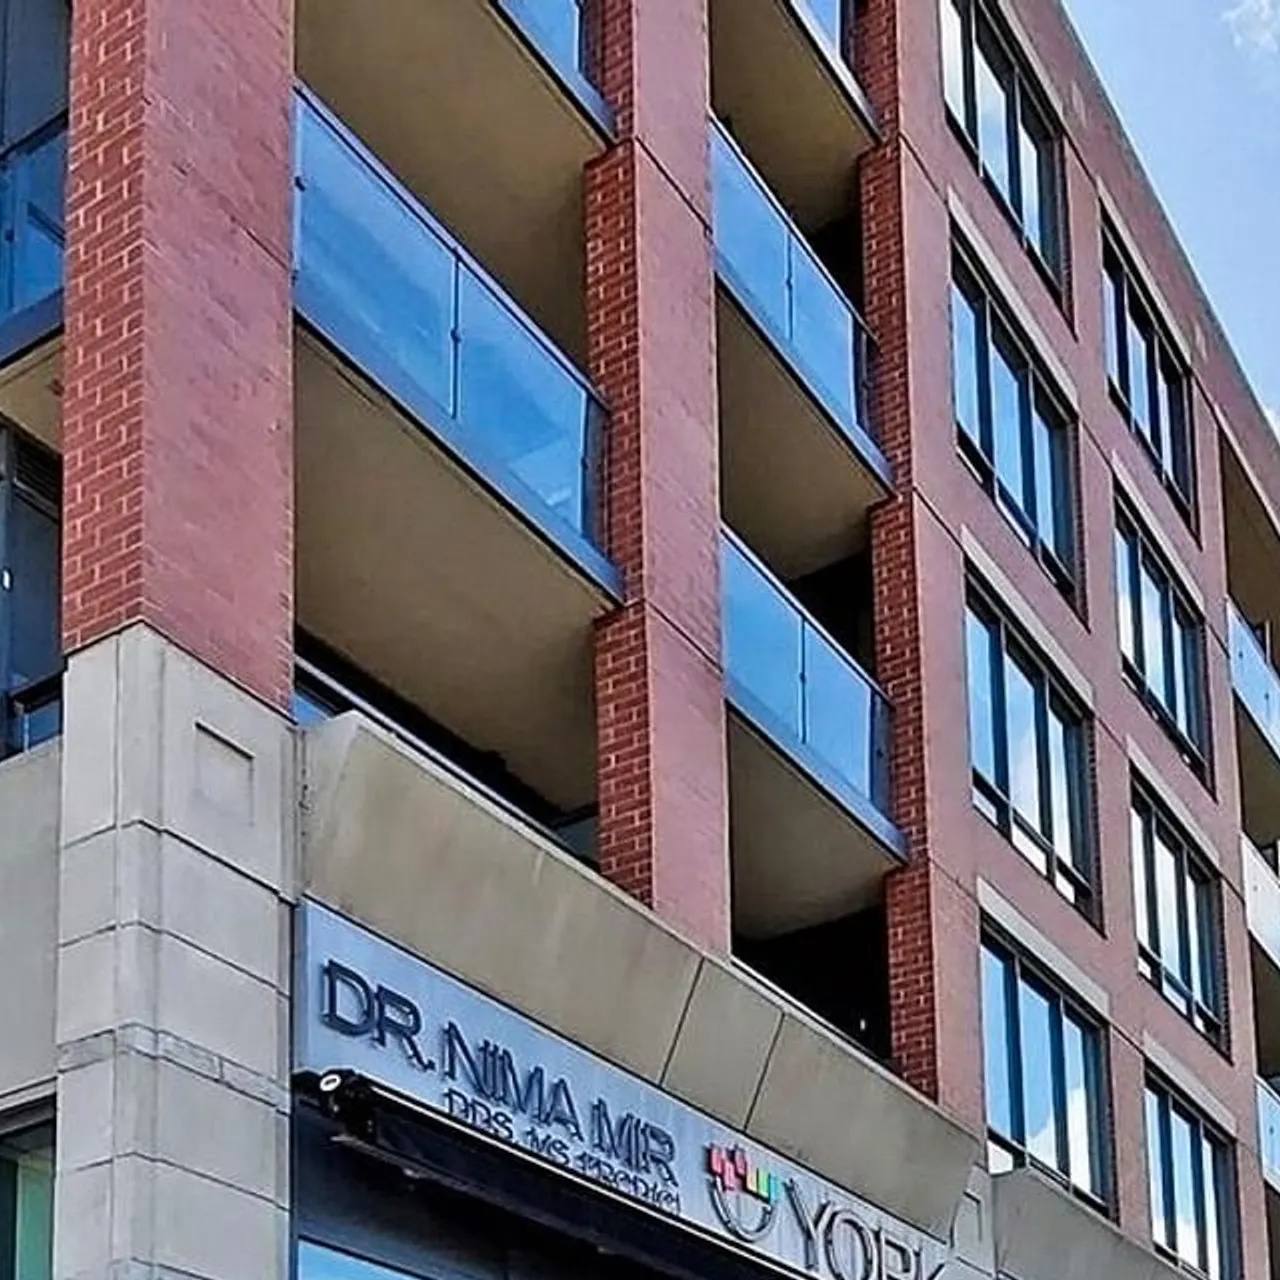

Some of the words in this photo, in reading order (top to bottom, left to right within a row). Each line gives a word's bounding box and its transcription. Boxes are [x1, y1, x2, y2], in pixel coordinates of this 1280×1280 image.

[320, 958, 435, 1073] DR.
[440, 1020, 584, 1143] NIMA
[590, 1096, 680, 1188] MIR
